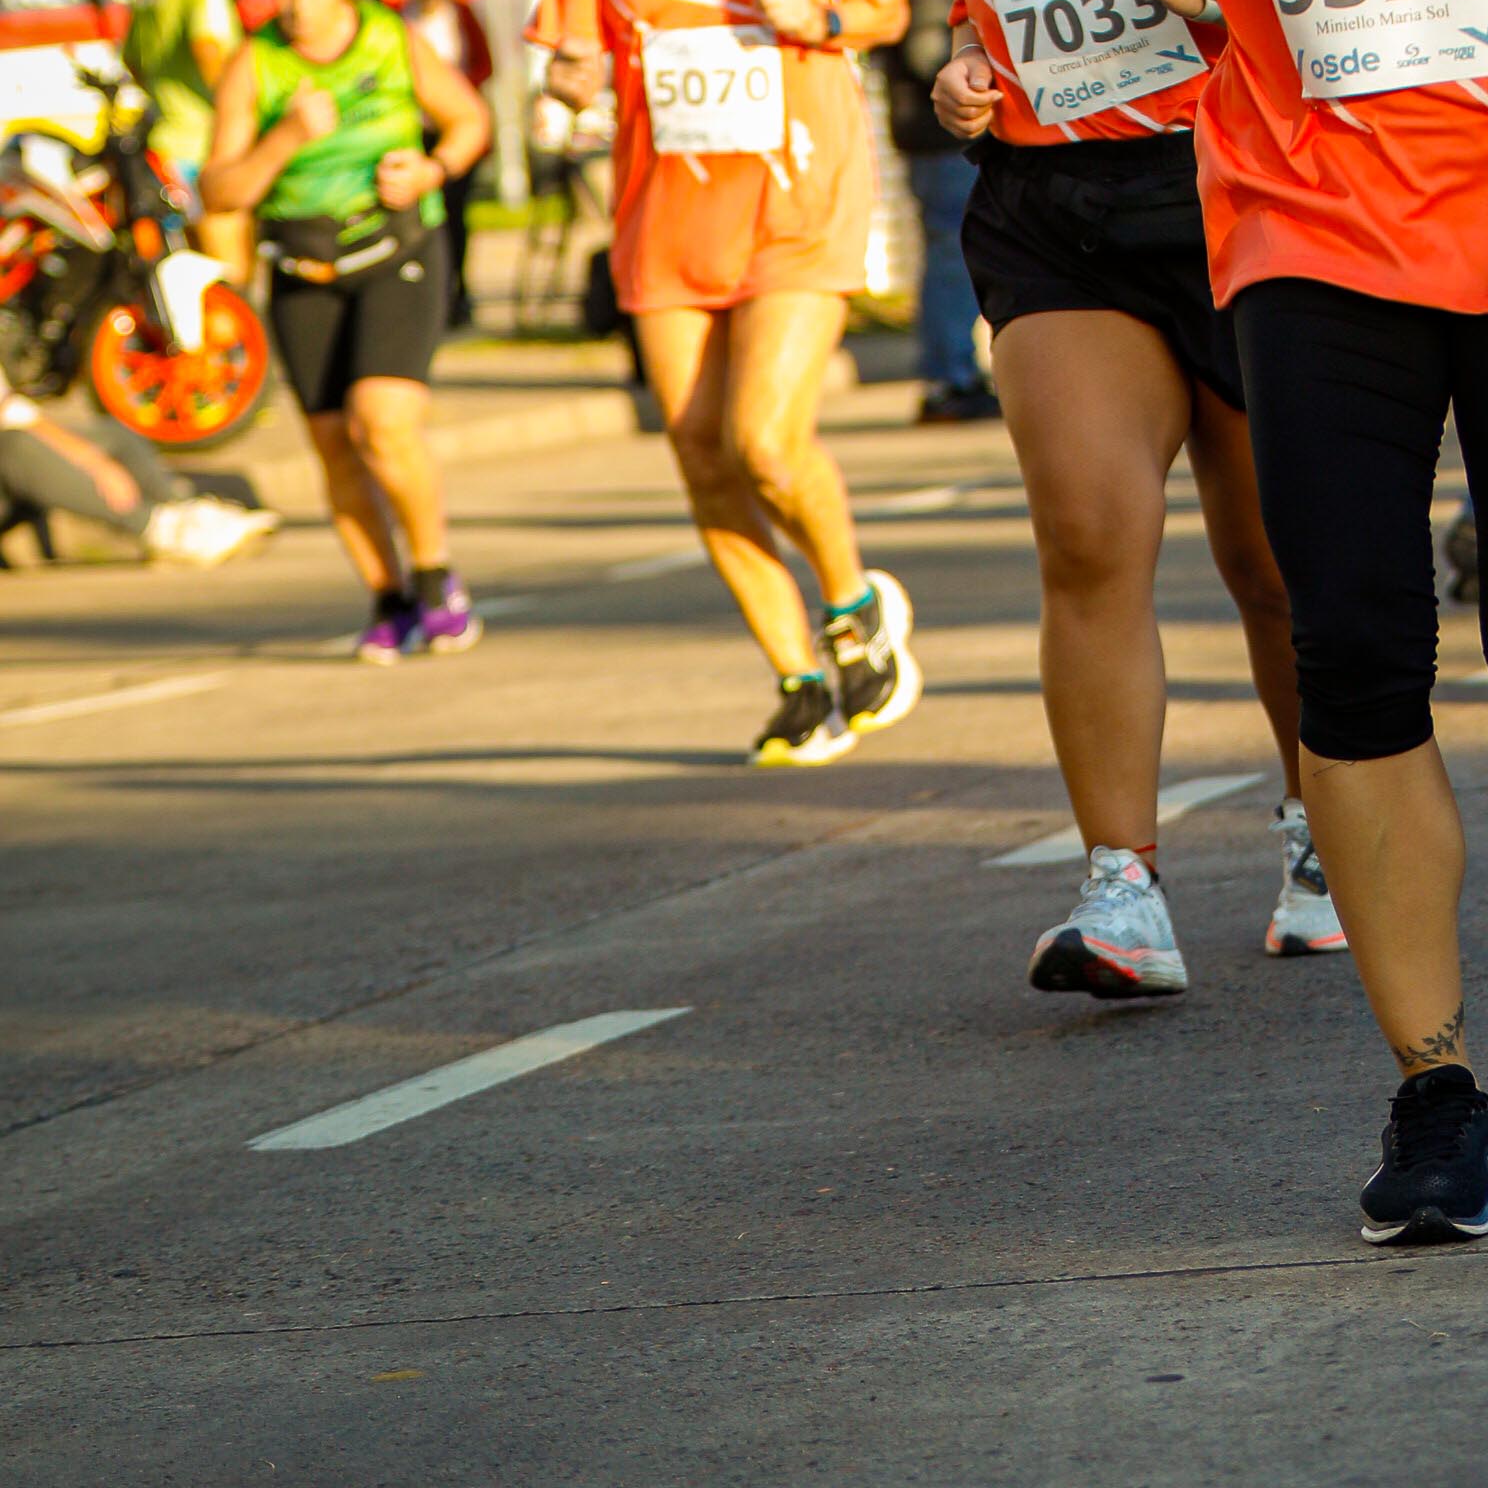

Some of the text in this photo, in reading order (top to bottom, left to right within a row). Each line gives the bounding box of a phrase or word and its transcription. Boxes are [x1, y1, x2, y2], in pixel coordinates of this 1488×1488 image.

[1316, 4, 1450, 36] Miniello Maria Sol
[1310, 48, 1381, 82] osde
[654, 66, 770, 108] 5070
[1052, 79, 1105, 109] osde
